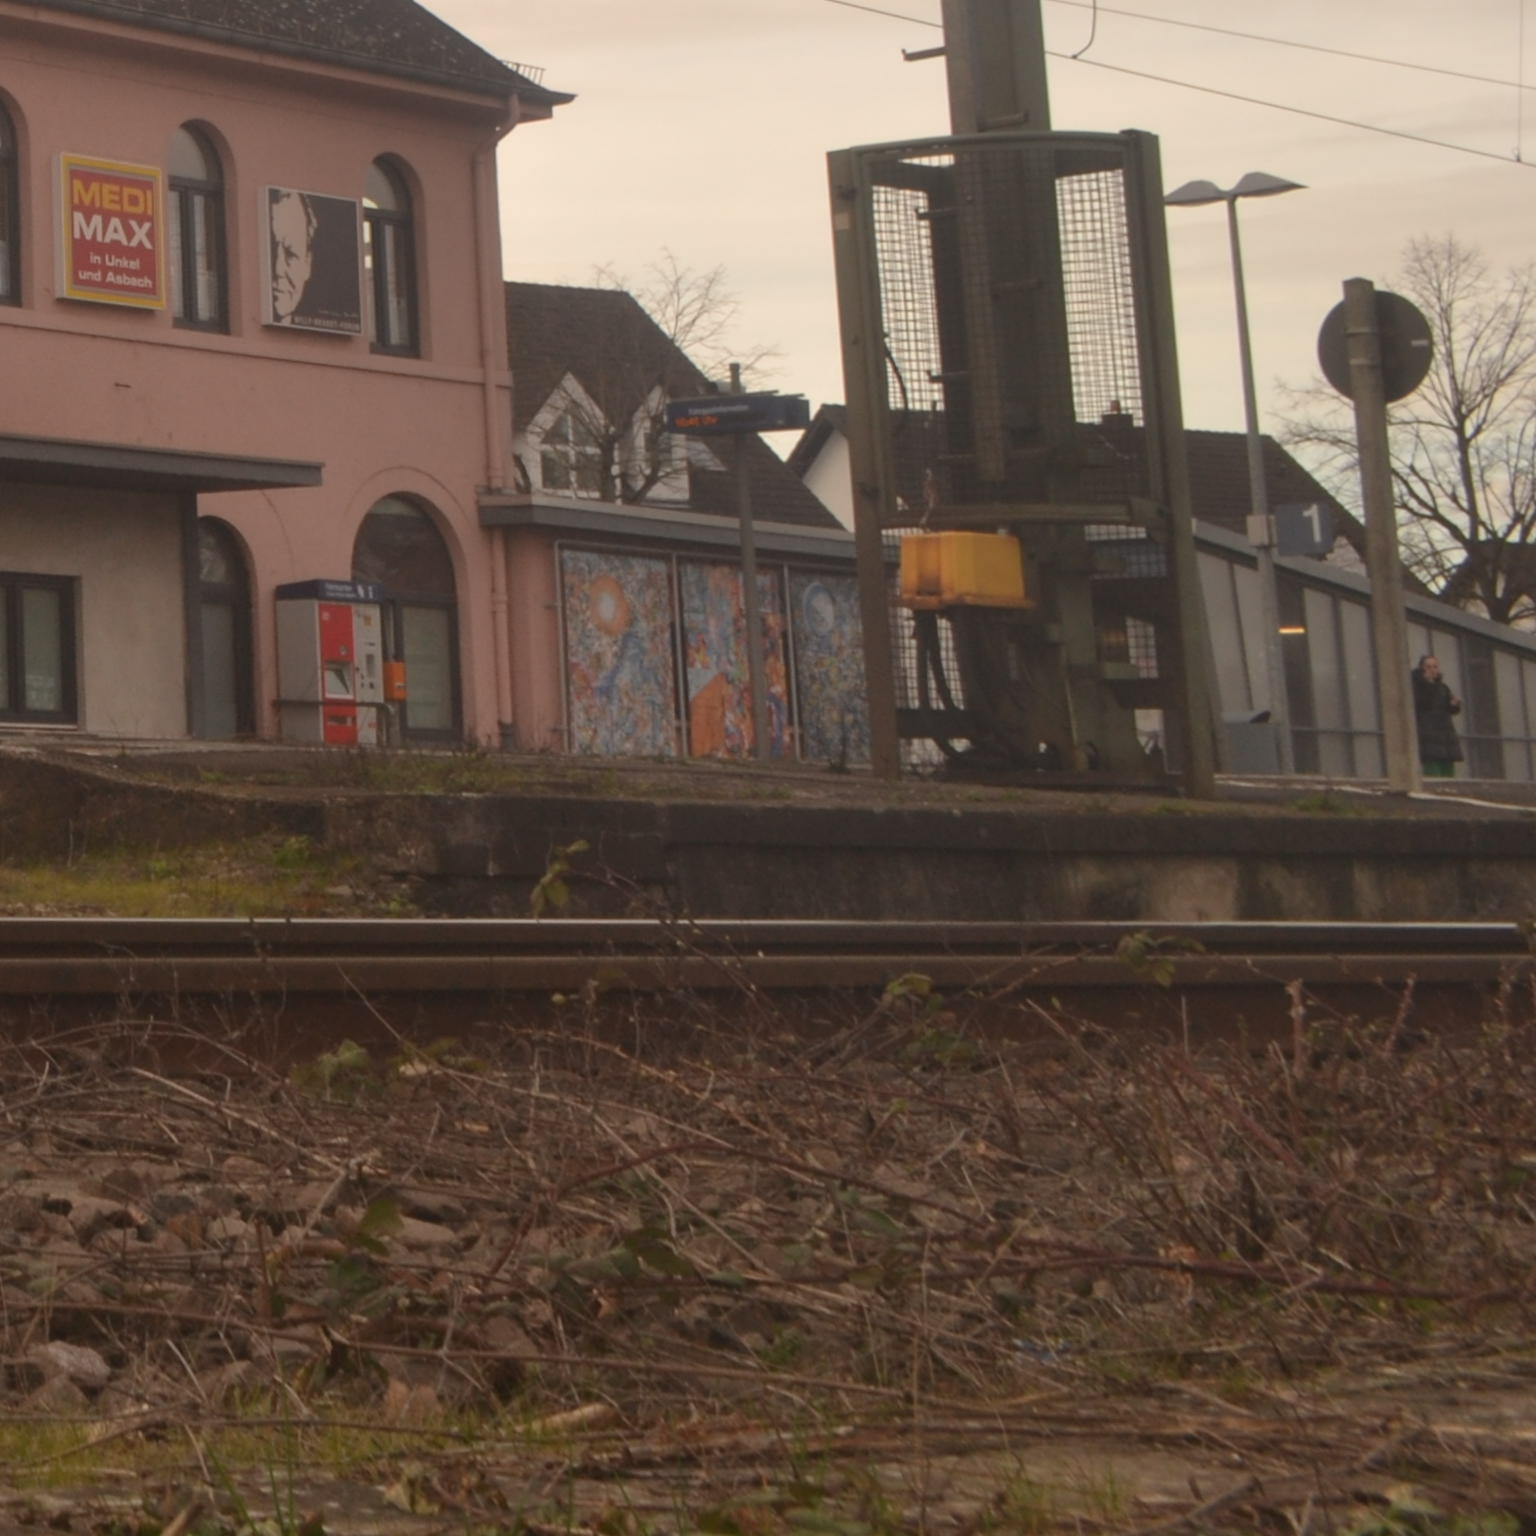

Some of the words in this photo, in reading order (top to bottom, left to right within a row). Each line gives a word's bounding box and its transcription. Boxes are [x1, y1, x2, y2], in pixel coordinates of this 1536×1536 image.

[72, 179, 153, 215] MEDI
[73, 211, 153, 249] MAX
[79, 269, 101, 282] und
[105, 272, 153, 288] Asbach
[90, 252, 101, 264] in
[105, 253, 140, 270] Unkel
[1302, 504, 1321, 543] 1
